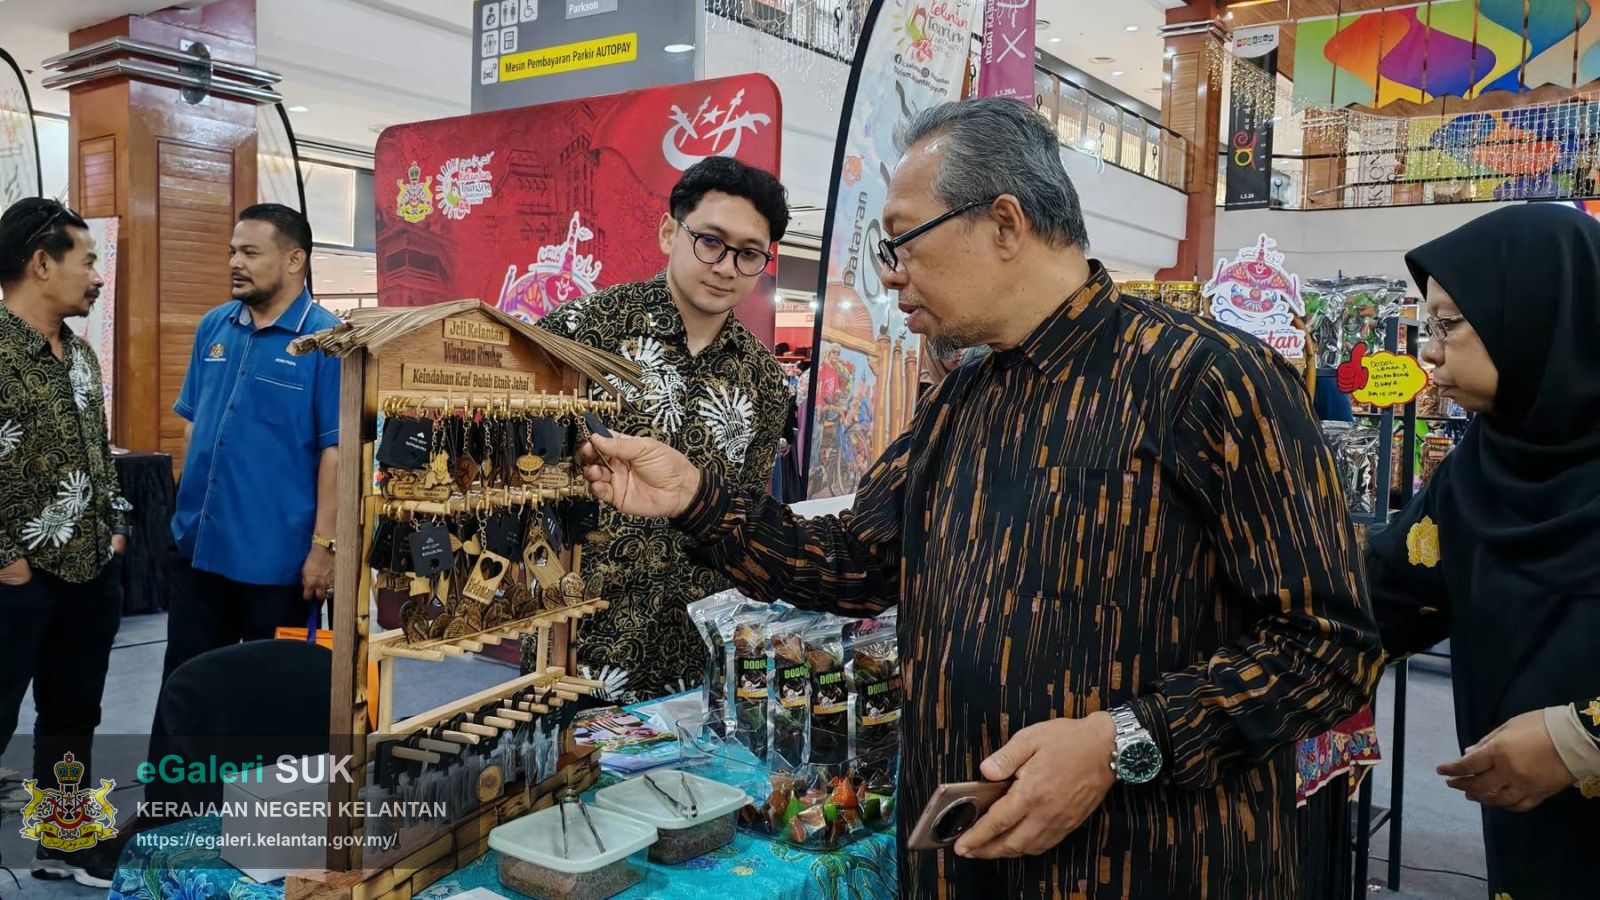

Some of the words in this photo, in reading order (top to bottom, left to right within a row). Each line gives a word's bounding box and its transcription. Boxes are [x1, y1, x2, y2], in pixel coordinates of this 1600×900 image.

[568, 1, 599, 14] Parkson
[505, 61, 526, 73] Mesin
[527, 54, 571, 69] Pembayaran
[572, 50, 595, 63] Parkir
[595, 41, 632, 58] AUTOPAY
[985, 31, 994, 64] KEDAI
[844, 191, 868, 288] Dataran
[450, 320, 466, 336] Jeli
[467, 323, 504, 341] Kelantan
[413, 368, 454, 386] Keindahan
[455, 372, 472, 386] Kraf
[472, 373, 493, 388] Buluh
[493, 375, 511, 389] Etnik
